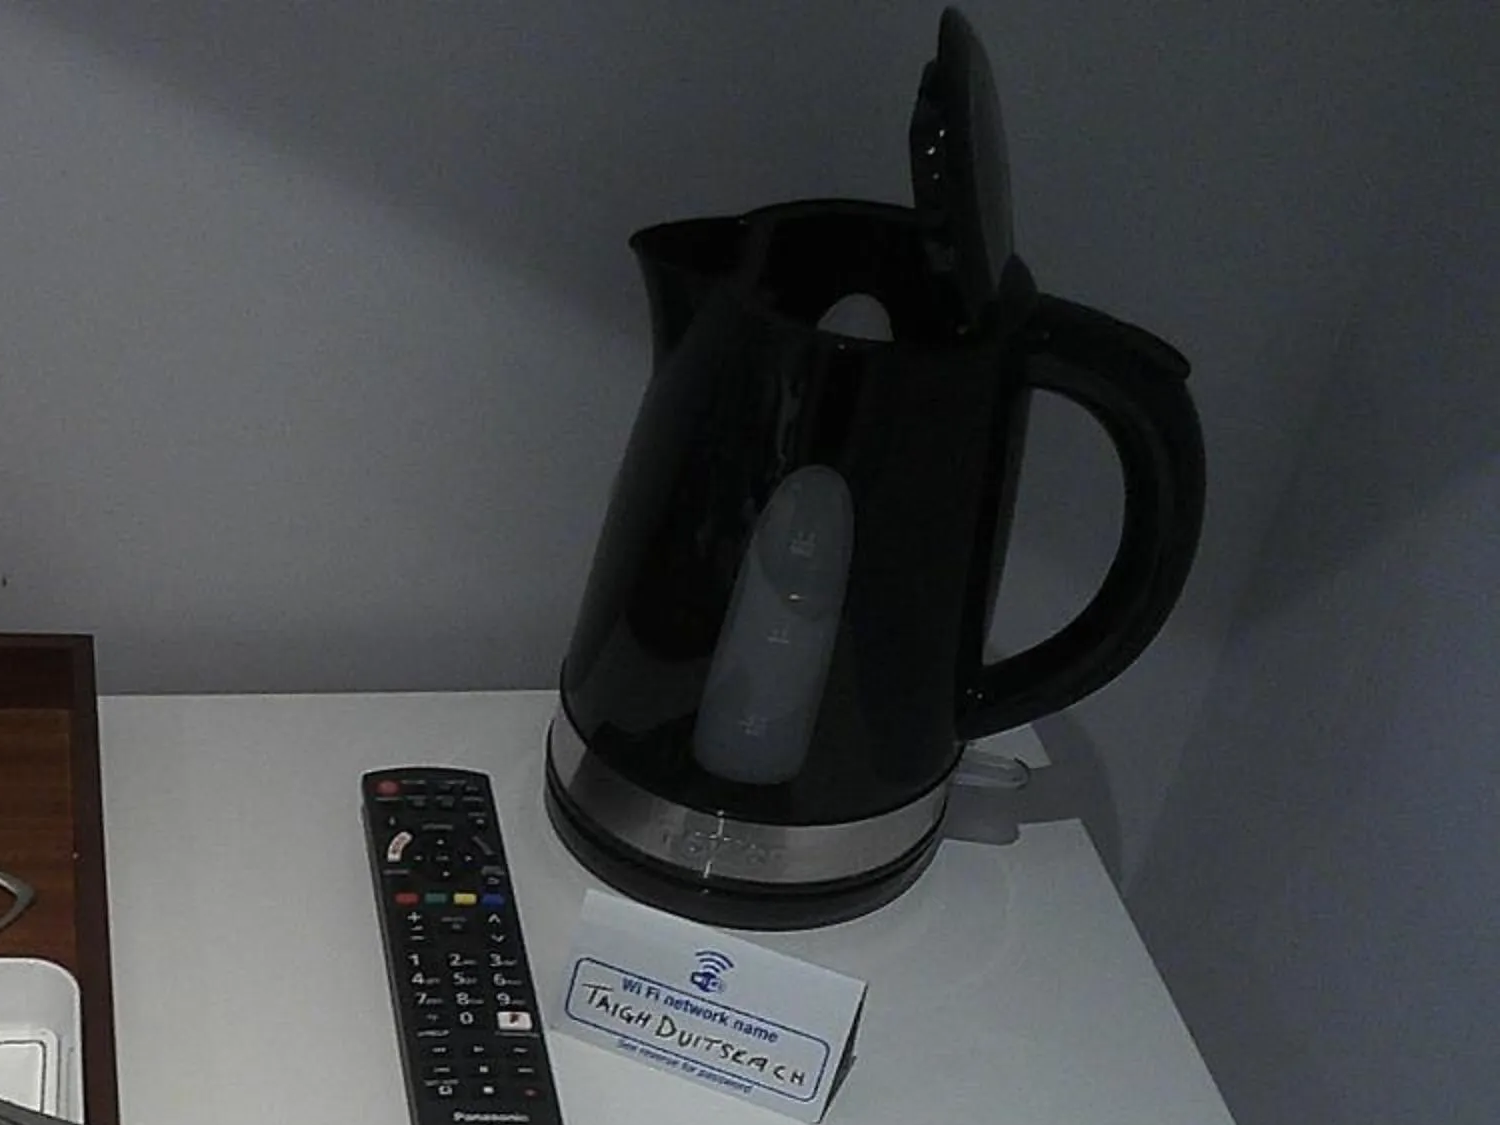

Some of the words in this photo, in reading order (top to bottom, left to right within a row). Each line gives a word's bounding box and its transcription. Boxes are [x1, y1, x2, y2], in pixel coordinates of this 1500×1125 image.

[582, 982, 650, 1029] TAIGH
[621, 976, 643, 993] Wi
[646, 983, 660, 1000] Fi
[664, 994, 728, 1028] network
[732, 1018, 779, 1043] name
[696, 1069, 754, 1094] password
[453, 1111, 530, 1122] Panasonic
